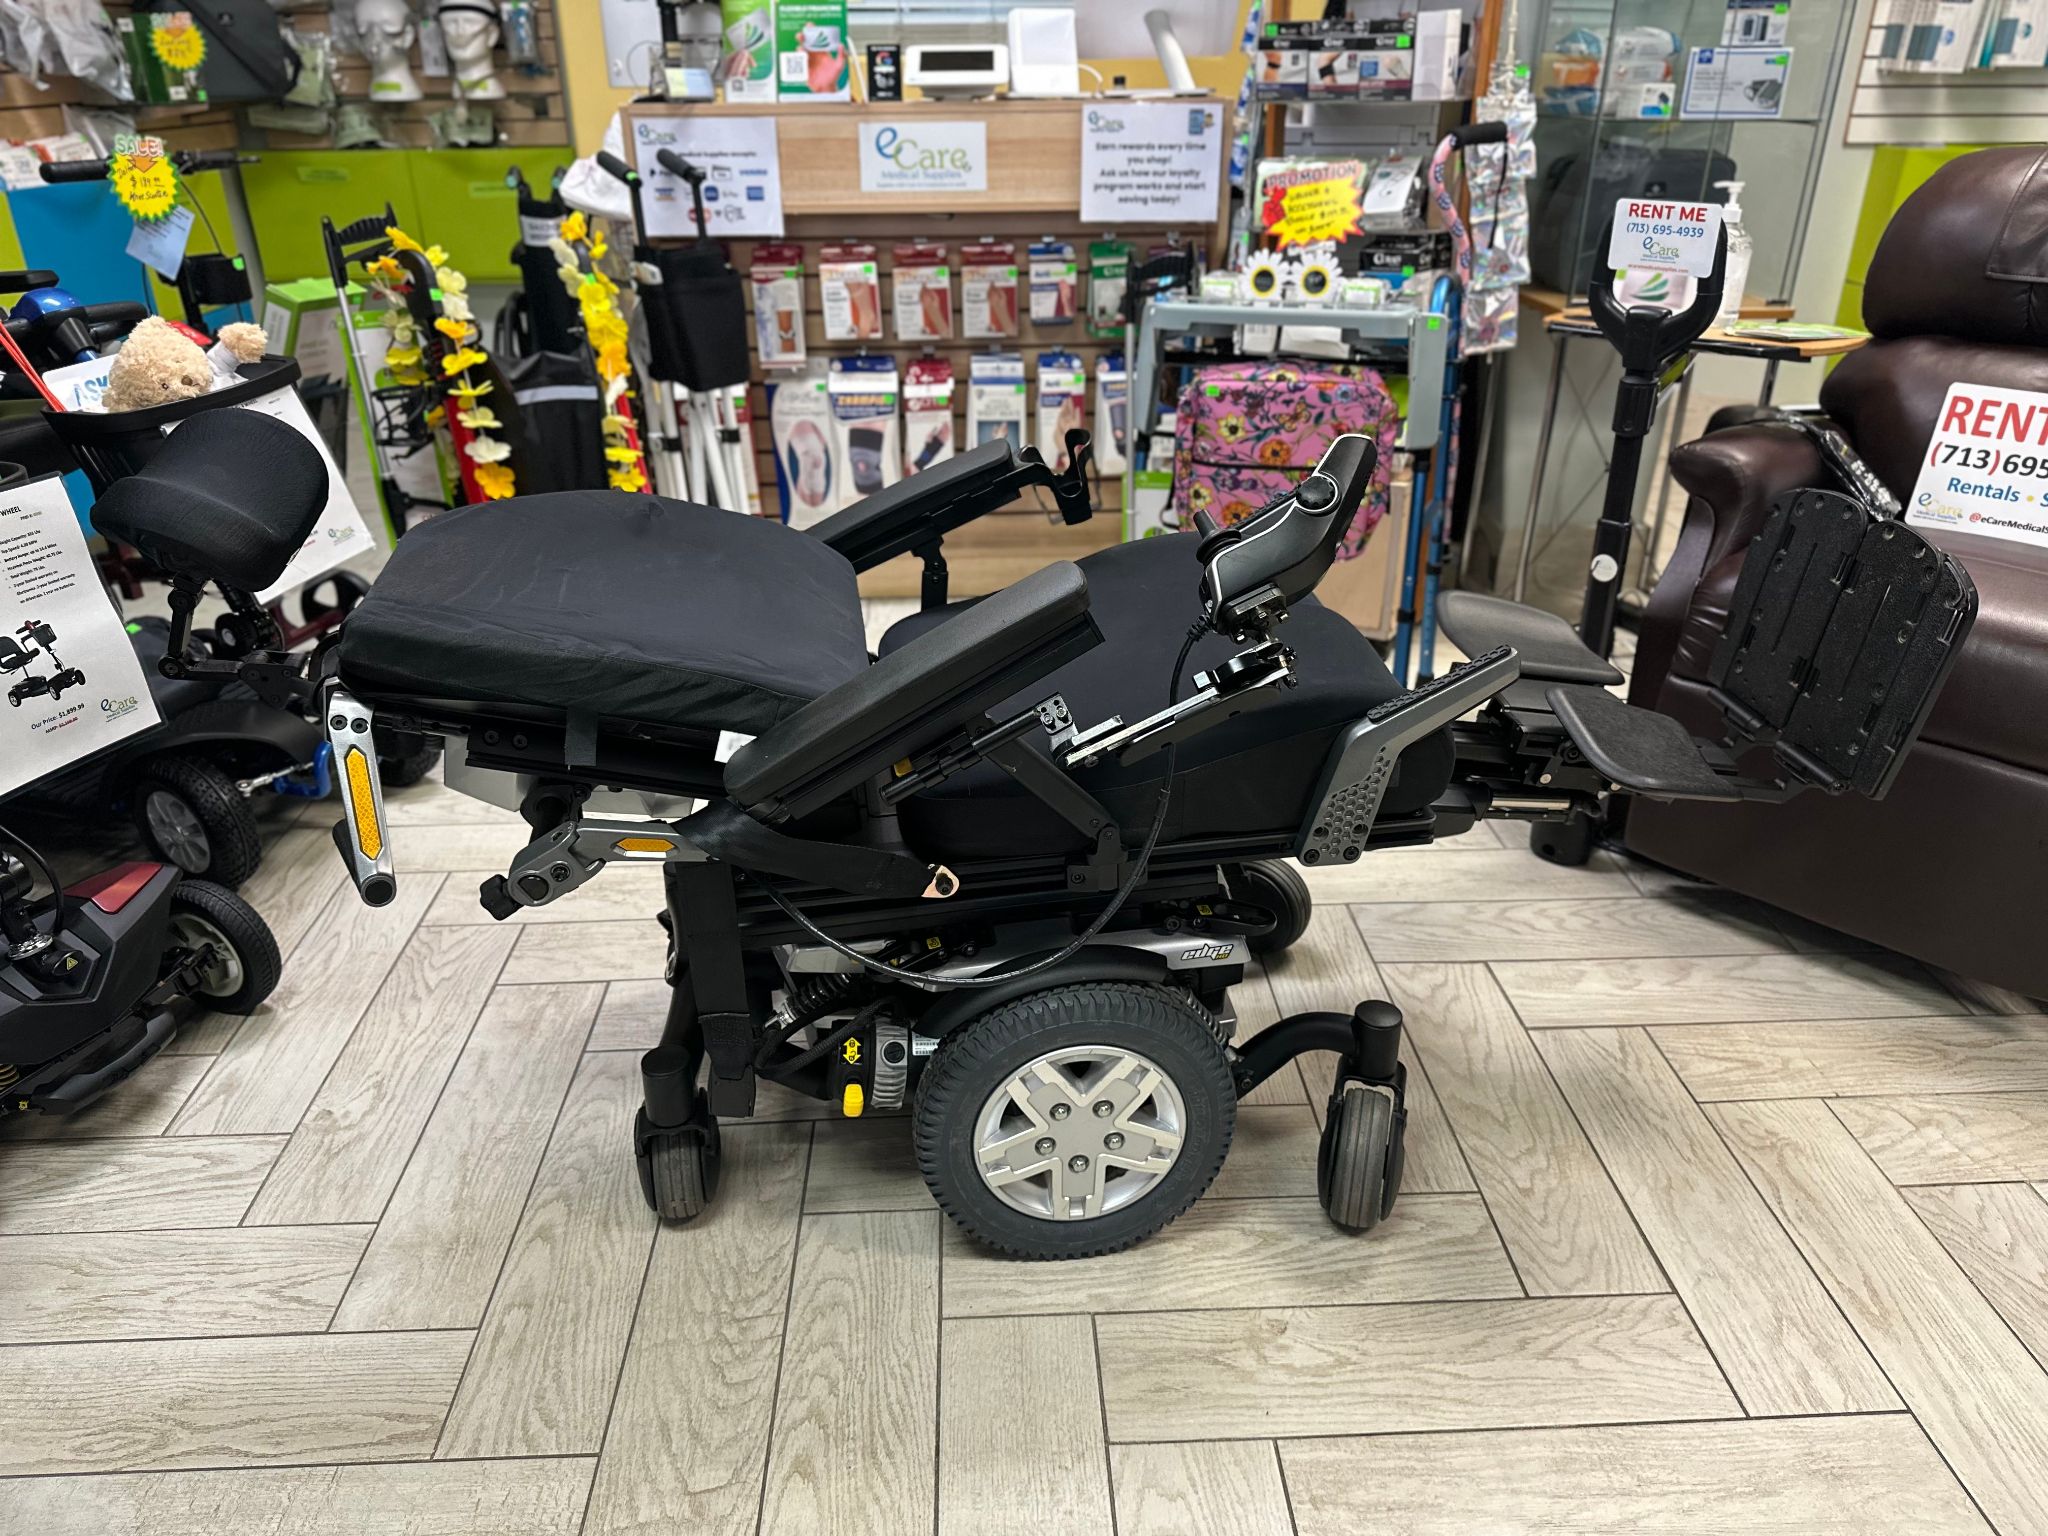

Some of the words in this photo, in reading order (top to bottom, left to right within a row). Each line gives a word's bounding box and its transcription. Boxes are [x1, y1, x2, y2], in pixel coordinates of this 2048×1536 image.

[875, 126, 969, 170] eCare
[1095, 142, 1116, 150] Earn
[1118, 142, 1155, 151] rewards
[1158, 143, 1183, 153] every
[1185, 142, 1206, 150] time
[1127, 157, 1144, 165] you
[1146, 156, 1172, 165] shop!
[1100, 168, 1116, 177] Ask
[1131, 168, 1149, 177] how
[1169, 168, 1200, 179] loyalty
[1268, 163, 1357, 187] PROMOTION
[1093, 182, 1133, 192] program
[1136, 181, 1162, 190] works
[1164, 181, 1182, 190] and
[1184, 182, 1206, 190] start
[1118, 195, 1149, 206] saving
[1151, 194, 1180, 205] today!
[1628, 203, 1676, 220] RENT
[1679, 206, 1708, 222] ME
[1626, 222, 1650, 234] (713)
[1652, 224, 1704, 238] 695-4939
[1643, 236, 1680, 258] eCare
[1942, 395, 2048, 446] RENT
[1947, 477, 2021, 502] Rentals
[0, 506, 21, 517] WHEEL
[1918, 492, 1963, 519] eCare
[100, 696, 138, 714] eCare
[31, 722, 42, 730] Our
[42, 714, 58, 727] Price:
[1180, 943, 1234, 961] edge
